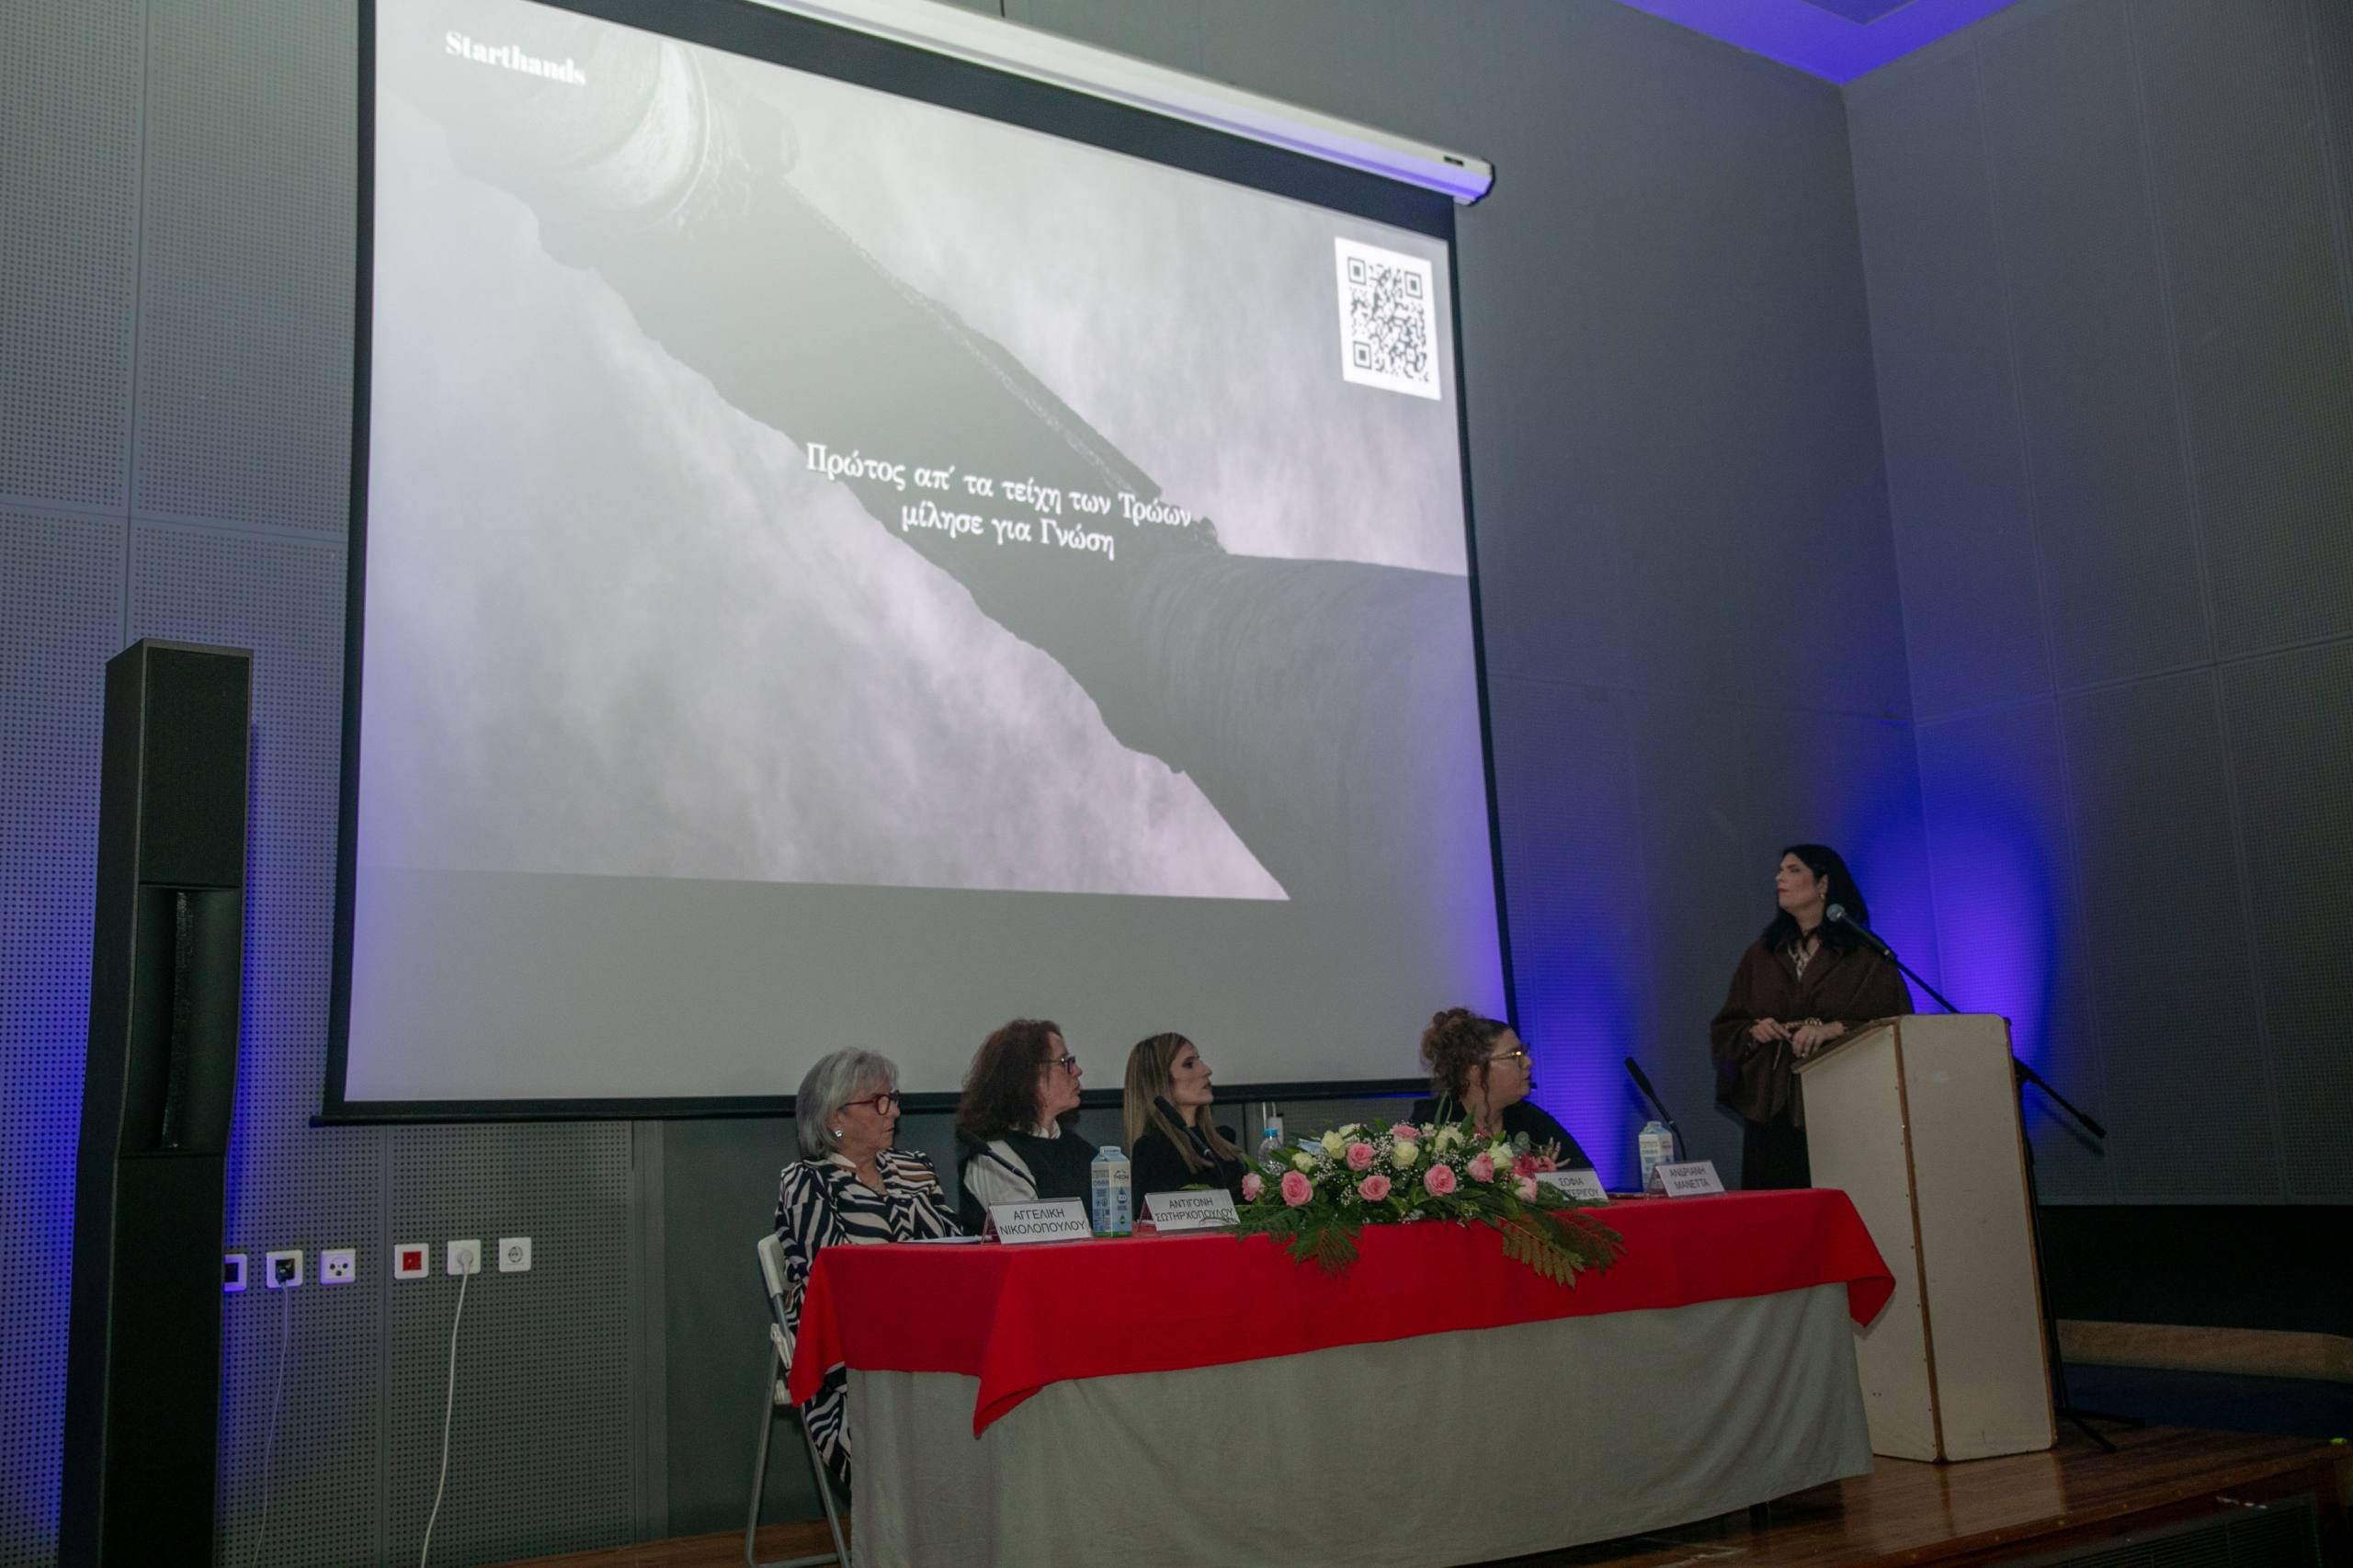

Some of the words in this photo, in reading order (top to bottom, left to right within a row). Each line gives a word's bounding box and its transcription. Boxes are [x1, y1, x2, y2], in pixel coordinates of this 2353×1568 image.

[806, 442, 906, 491] Πρώτος
[963, 474, 995, 497] τα
[1002, 477, 1062, 515] τείχη
[1068, 491, 1111, 515] των
[1118, 492, 1192, 527] Τρώων
[902, 500, 984, 539] μίλησε
[991, 517, 1032, 545] για
[1040, 517, 1115, 561] Γνώση
[1169, 1197, 1213, 1209] ΑΝΤΙΓΟΝΗ
[1014, 1208, 1065, 1221] ΑΓΓΕΛΙΚΗ
[999, 1220, 1086, 1235] ΝΙΚΟΛΟΠΟΥΛΟΥ
